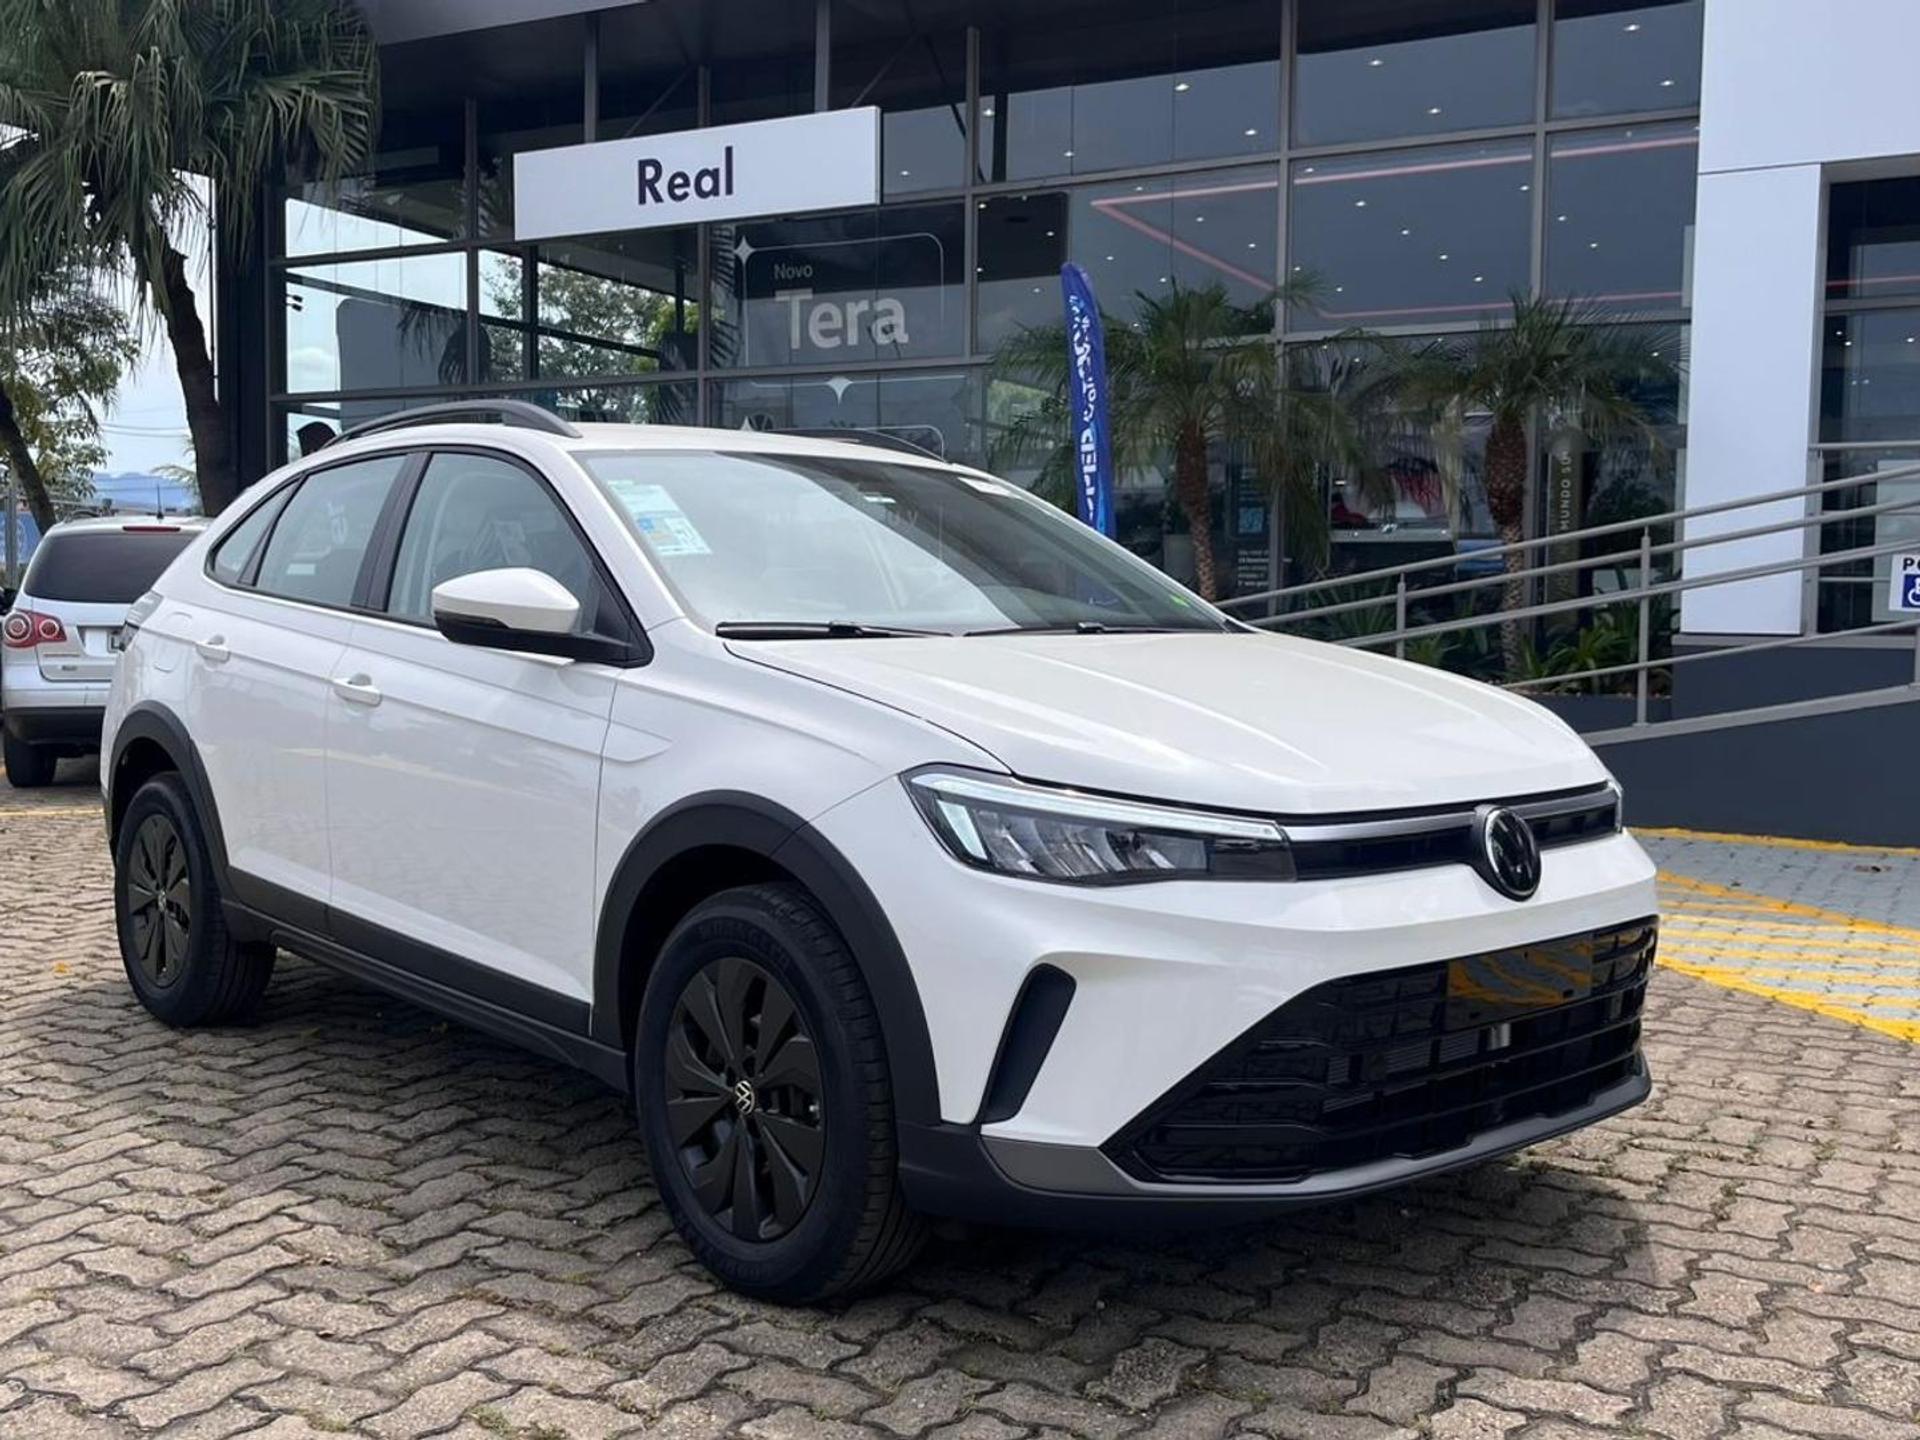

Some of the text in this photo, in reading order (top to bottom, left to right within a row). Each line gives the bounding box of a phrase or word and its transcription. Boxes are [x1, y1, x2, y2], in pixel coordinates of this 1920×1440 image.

[637, 145, 734, 205] Real
[773, 263, 813, 280] Novo
[774, 287, 909, 350] Tera
[1560, 478, 1571, 531] MUNDO
